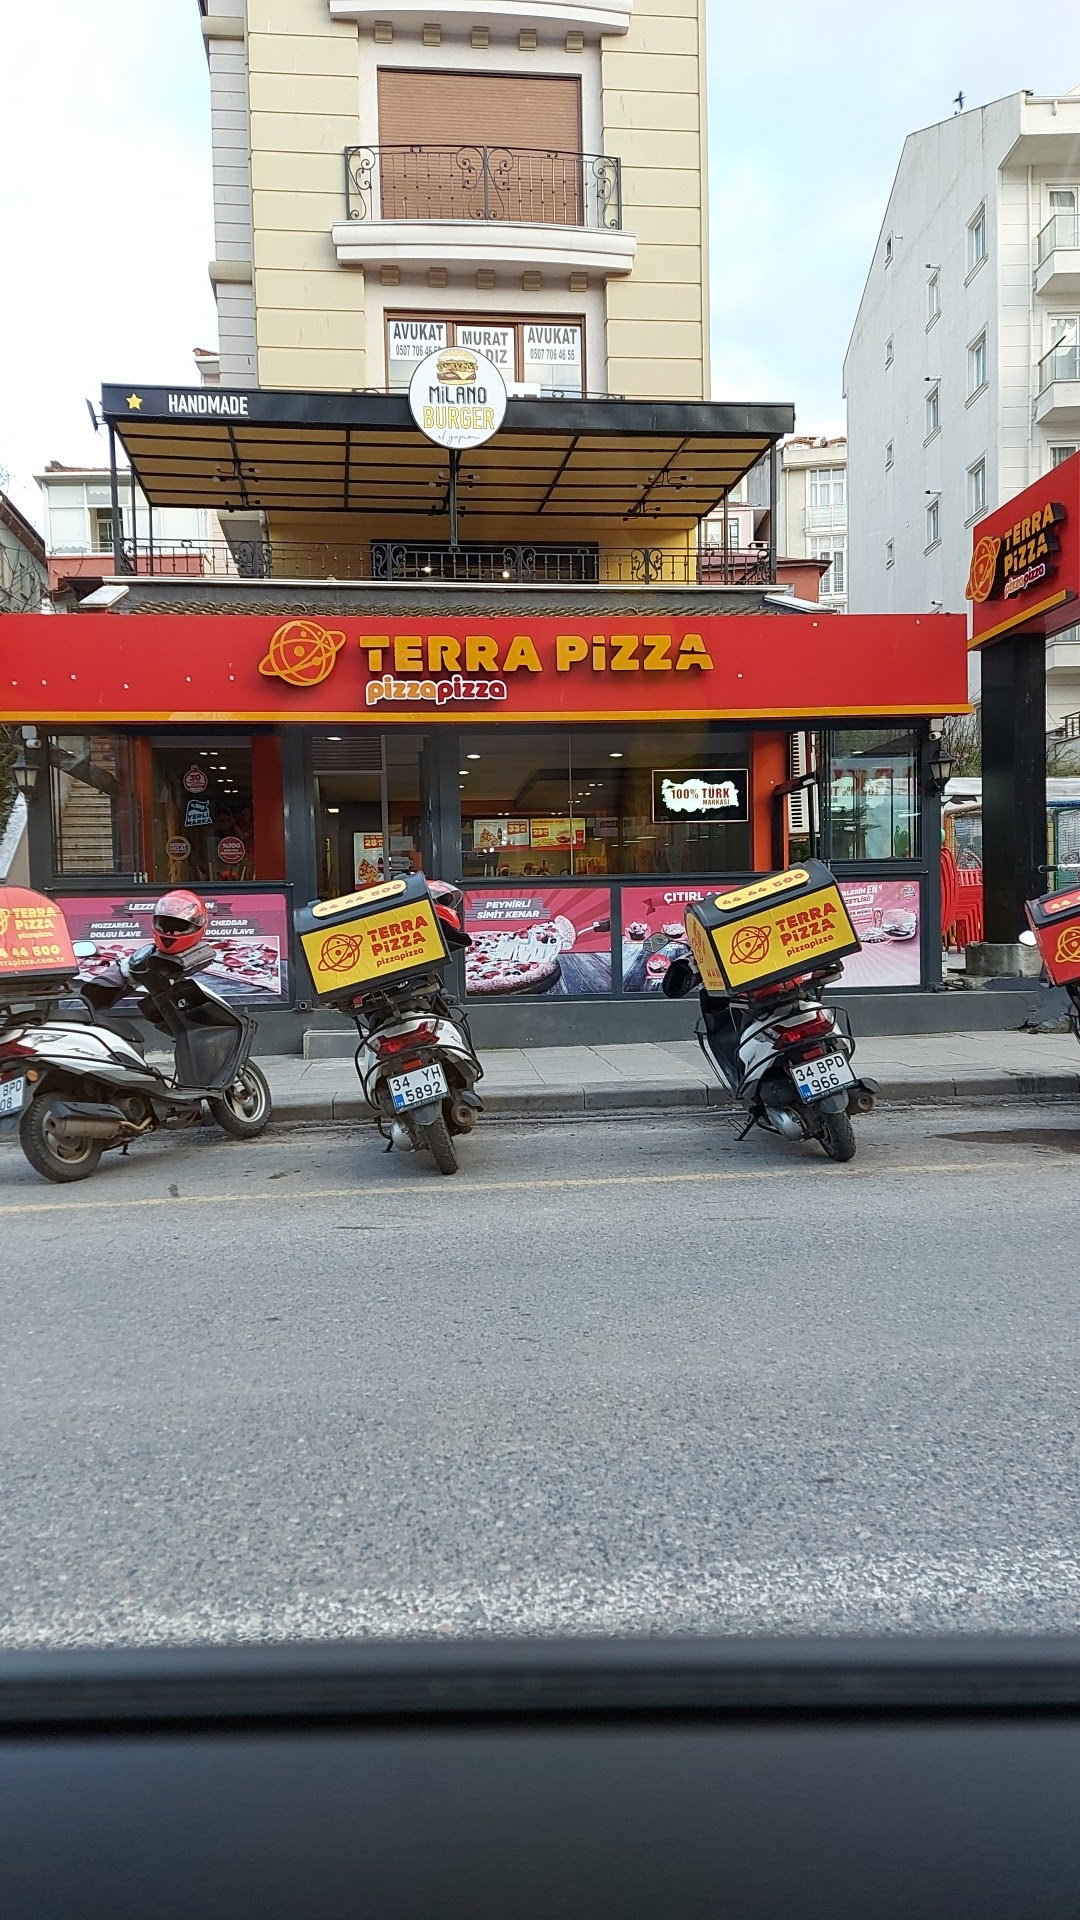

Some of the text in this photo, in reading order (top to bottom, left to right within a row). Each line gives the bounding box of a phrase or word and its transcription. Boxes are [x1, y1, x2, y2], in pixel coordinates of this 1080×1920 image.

[394, 323, 443, 340] AVUKAT
[462, 331, 508, 346] MURAT
[528, 327, 577, 344] AVUKAT
[396, 345, 410, 356] 0507
[412, 345, 423, 356] 706
[530, 348, 575, 360] 0507 706 46 55
[168, 394, 248, 415] HANDMADE
[423, 406, 495, 430] BURGER
[1004, 503, 1054, 551] TERRA
[359, 635, 543, 671] TERRA
[366, 674, 507, 705] pizzapizza
[671, 787, 729, 799] 100% TÜRK
[772, 873, 804, 887] 500
[371, 884, 402, 896] 500
[12, 907, 56, 919] TERRA
[486, 899, 531, 909] PEYNİRLİ
[477, 909, 540, 919] SİMİT KENAR
[775, 903, 837, 932] TERRA
[367, 916, 428, 942] TERRA
[32, 945, 60, 956] 500
[786, 934, 834, 957] pizzapizza
[376, 948, 424, 967] pizzapizza
[796, 1056, 844, 1081] 34 BPD
[393, 1066, 441, 1091] 34 YH
[811, 1073, 839, 1092] 966
[3, 1080, 21, 1096] BPD
[405, 1081, 442, 1102] 5892
